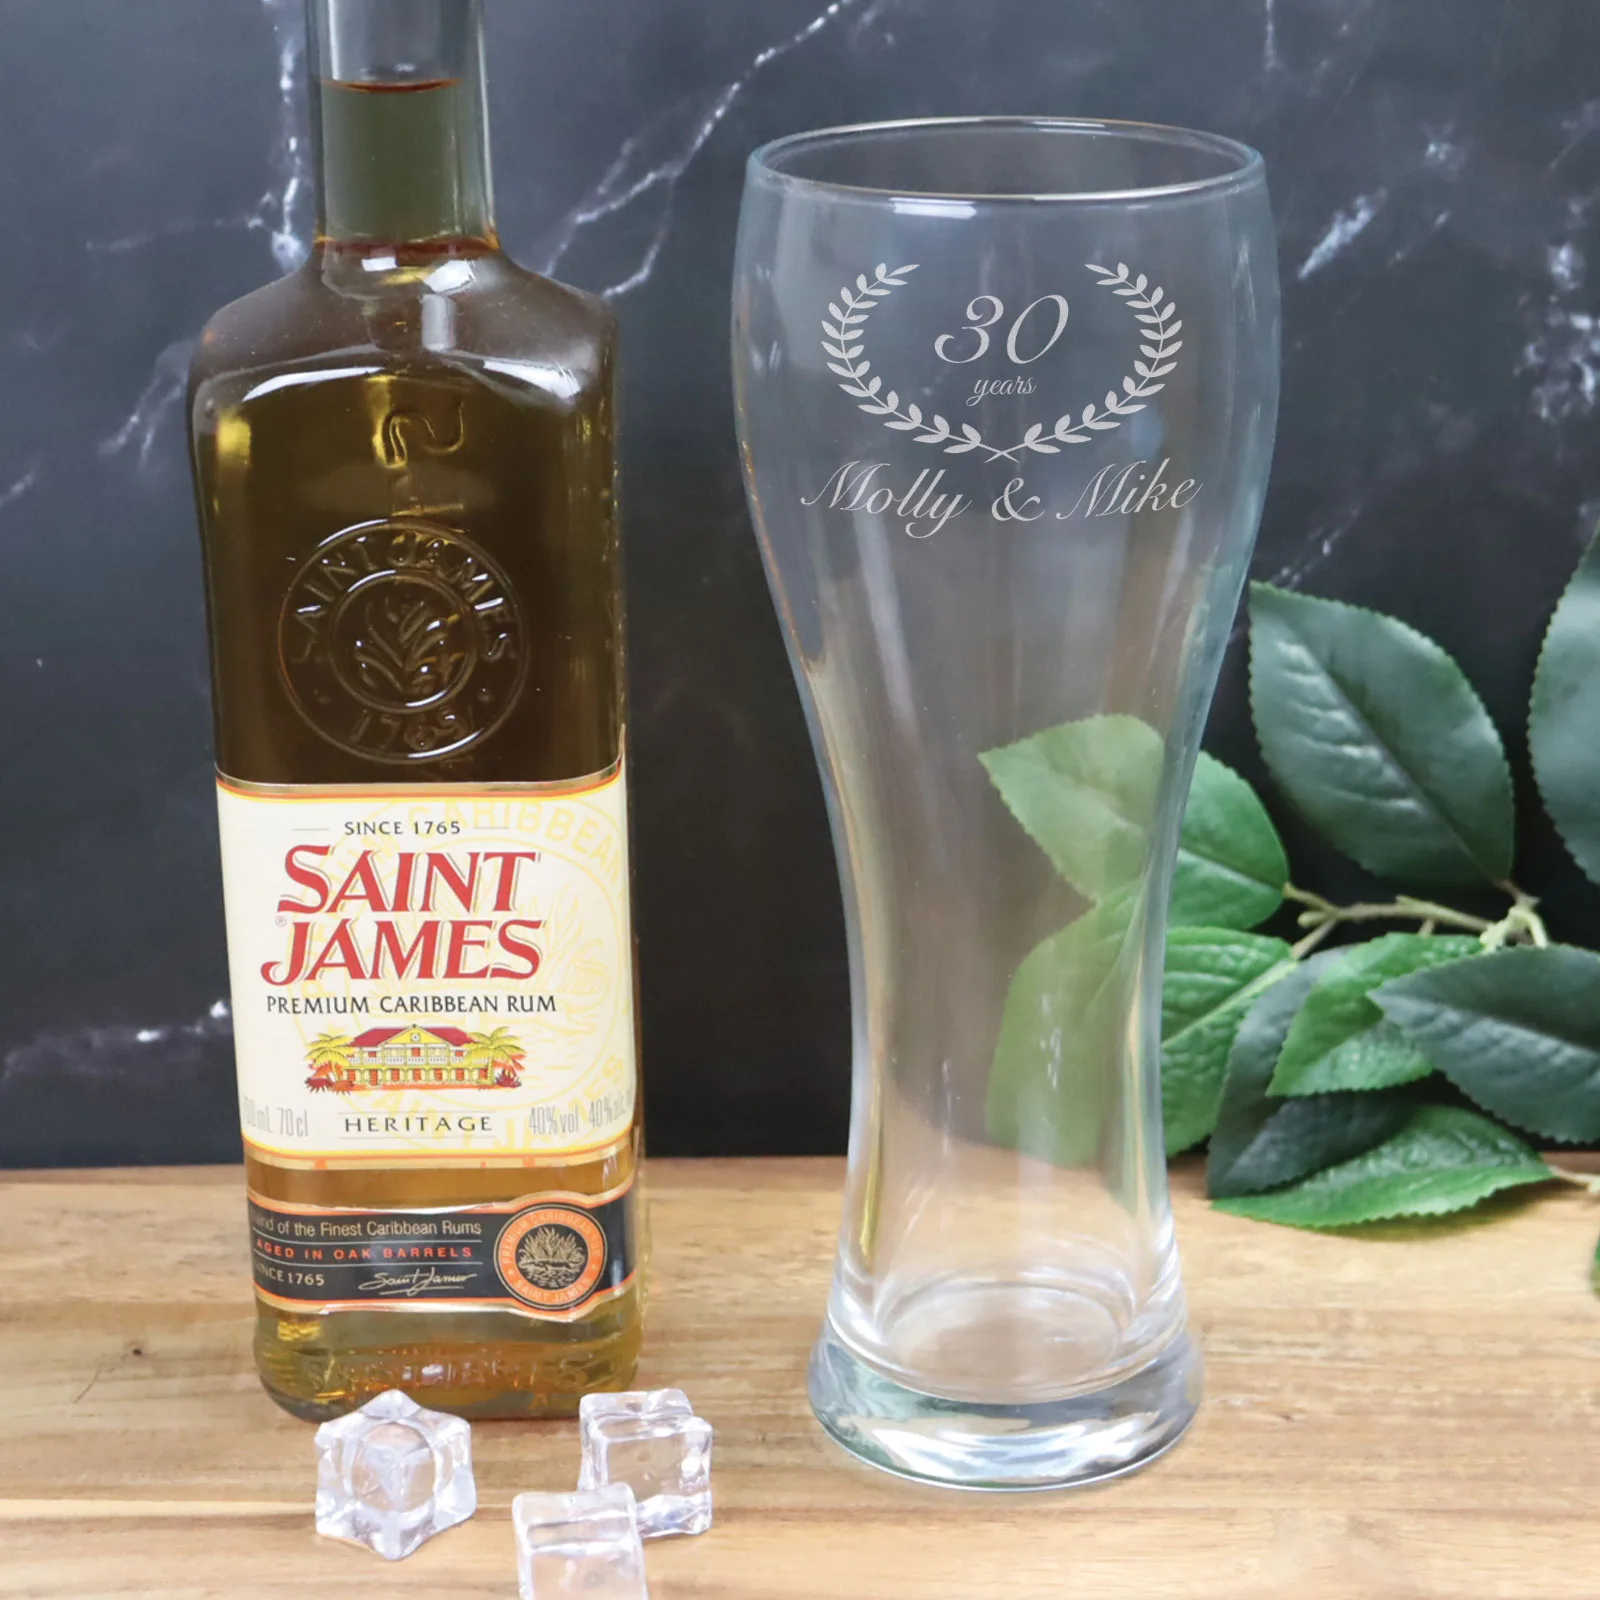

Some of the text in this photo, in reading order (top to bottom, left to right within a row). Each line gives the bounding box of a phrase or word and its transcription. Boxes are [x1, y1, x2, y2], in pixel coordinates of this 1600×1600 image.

[934, 294, 1069, 364] 30
[966, 374, 1037, 406] years
[800, 457, 1204, 539] Molly & Mike
[344, 820, 462, 836] SINCE 1765
[277, 843, 539, 914] SAINT
[260, 915, 546, 987] JAMES
[266, 994, 557, 1014] PREMIUM CARIBBEAN RUM
[344, 1116, 493, 1132] HERITAGE
[277, 1220, 291, 1234] of
[294, 1221, 316, 1237] the
[320, 1222, 363, 1237] Finest
[366, 1219, 438, 1236] Caribbean
[442, 1219, 483, 1235] Rums
[256, 1238, 473, 1260] AGED IN OAK BARRELS
[287, 1272, 326, 1287] 1765
